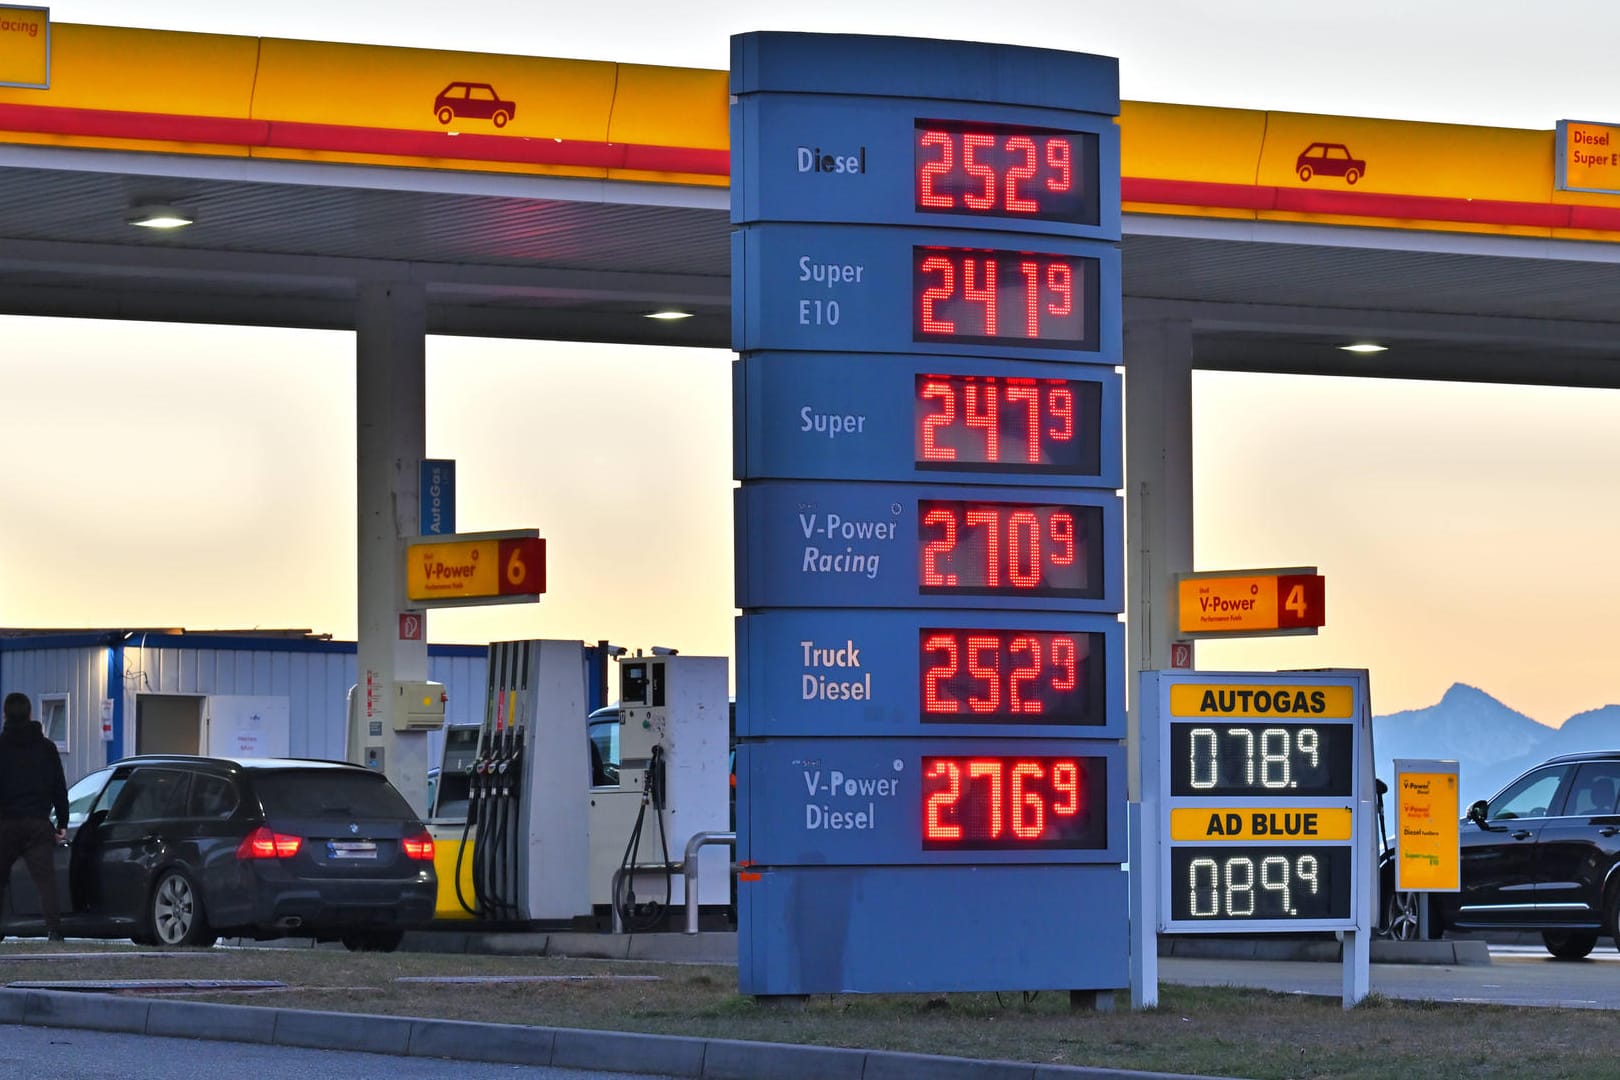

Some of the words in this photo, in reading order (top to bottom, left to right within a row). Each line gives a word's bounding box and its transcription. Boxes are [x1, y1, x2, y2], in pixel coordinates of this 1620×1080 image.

[0, 17, 38, 37] acing
[1574, 130, 1609, 146] Diesel
[798, 146, 866, 174] Diesel
[1574, 151, 1608, 168] Super
[1611, 153, 1620, 166] E
[799, 256, 864, 288] Super
[799, 300, 840, 325] E10
[800, 406, 866, 438] Super
[799, 514, 898, 540] V-Power
[424, 562, 477, 580] V-Power
[507, 548, 526, 586] 6
[802, 546, 880, 579] Racing
[1199, 596, 1256, 612] V-Power
[1285, 584, 1308, 619] 4
[801, 640, 861, 667] Truck
[802, 672, 872, 700] Diesel
[1200, 690, 1326, 713] AUTOGAS
[803, 770, 900, 796] V-Power
[806, 802, 874, 830] Diesel
[1206, 813, 1242, 836] AD
[1252, 813, 1319, 836] BLUE
